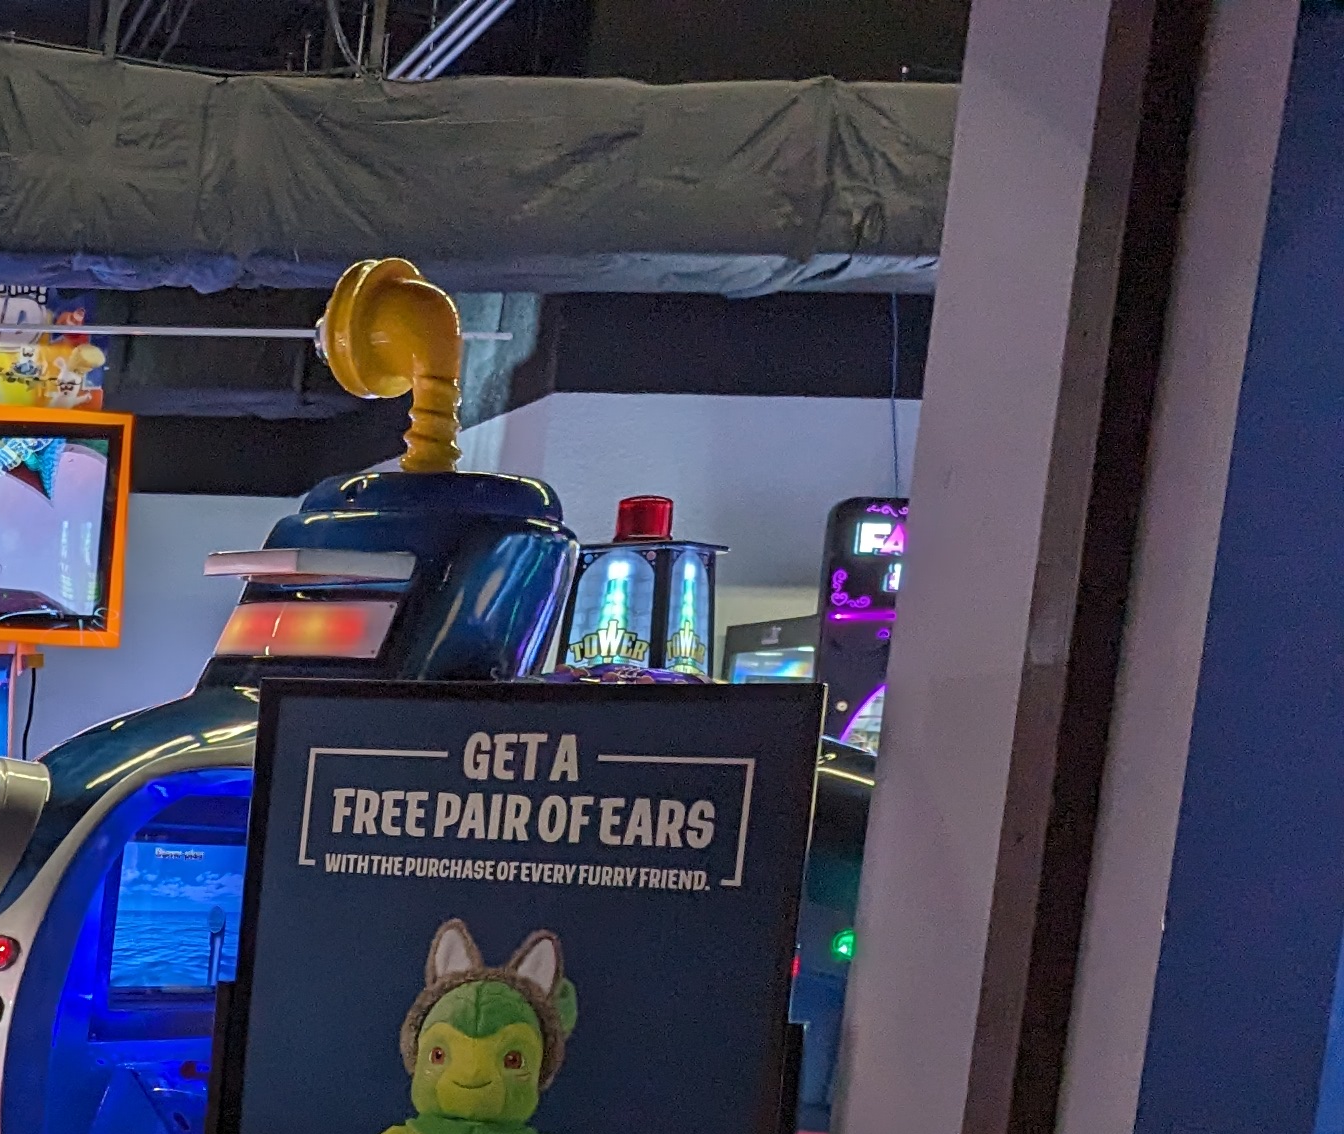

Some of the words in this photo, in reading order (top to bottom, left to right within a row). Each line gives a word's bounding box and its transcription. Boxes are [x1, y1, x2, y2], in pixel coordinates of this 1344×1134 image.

[569, 619, 650, 662] TOWER
[463, 731, 549, 781] GET
[549, 734, 579, 782] A
[331, 787, 429, 837] FREE
[433, 791, 531, 842] PAIR
[538, 795, 595, 843] OF
[598, 797, 716, 849] EARS
[325, 852, 370, 875] WITH
[370, 855, 404, 877] THE
[405, 856, 495, 881] PURCHASE
[496, 860, 521, 882] OF
[520, 861, 577, 885] EVERY
[578, 864, 637, 887] FURRY
[638, 867, 711, 891] FRIEND.
